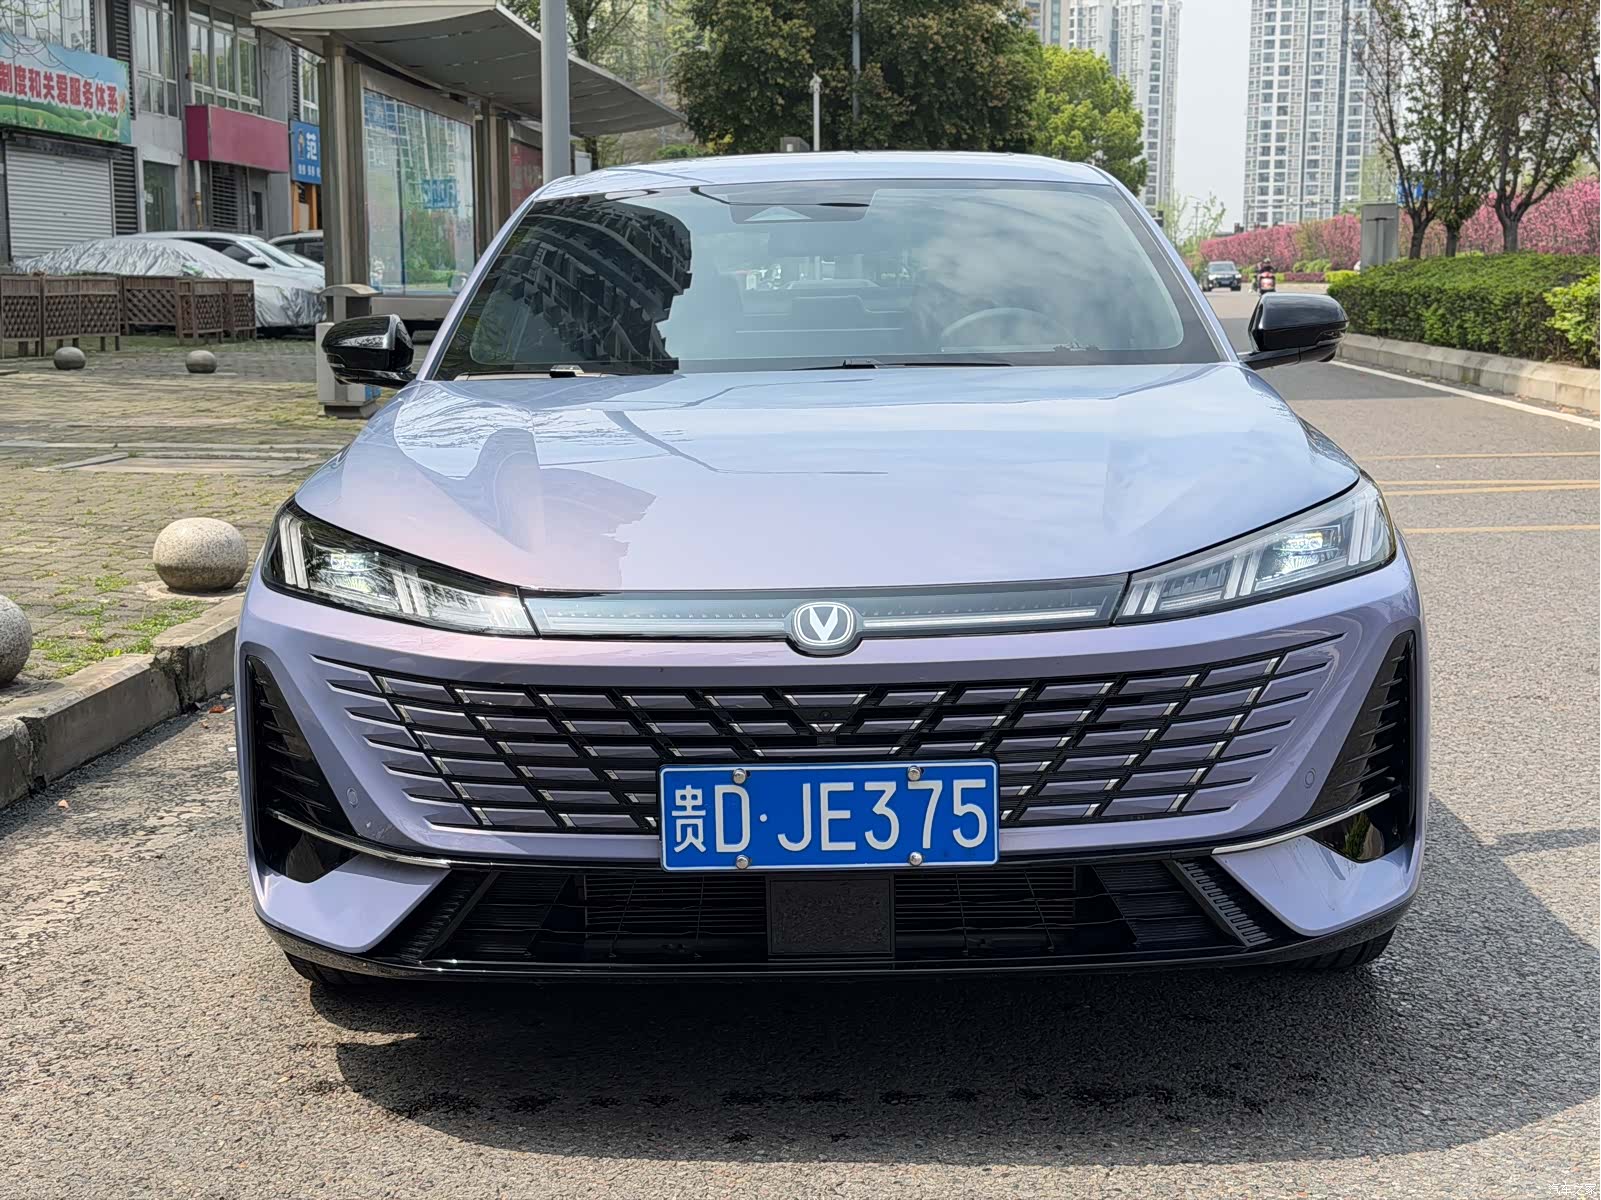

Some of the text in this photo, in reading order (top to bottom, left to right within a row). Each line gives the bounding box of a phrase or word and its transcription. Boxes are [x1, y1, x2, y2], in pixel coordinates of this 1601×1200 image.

[0, 60, 118, 113] 制度和关爱服务体系
